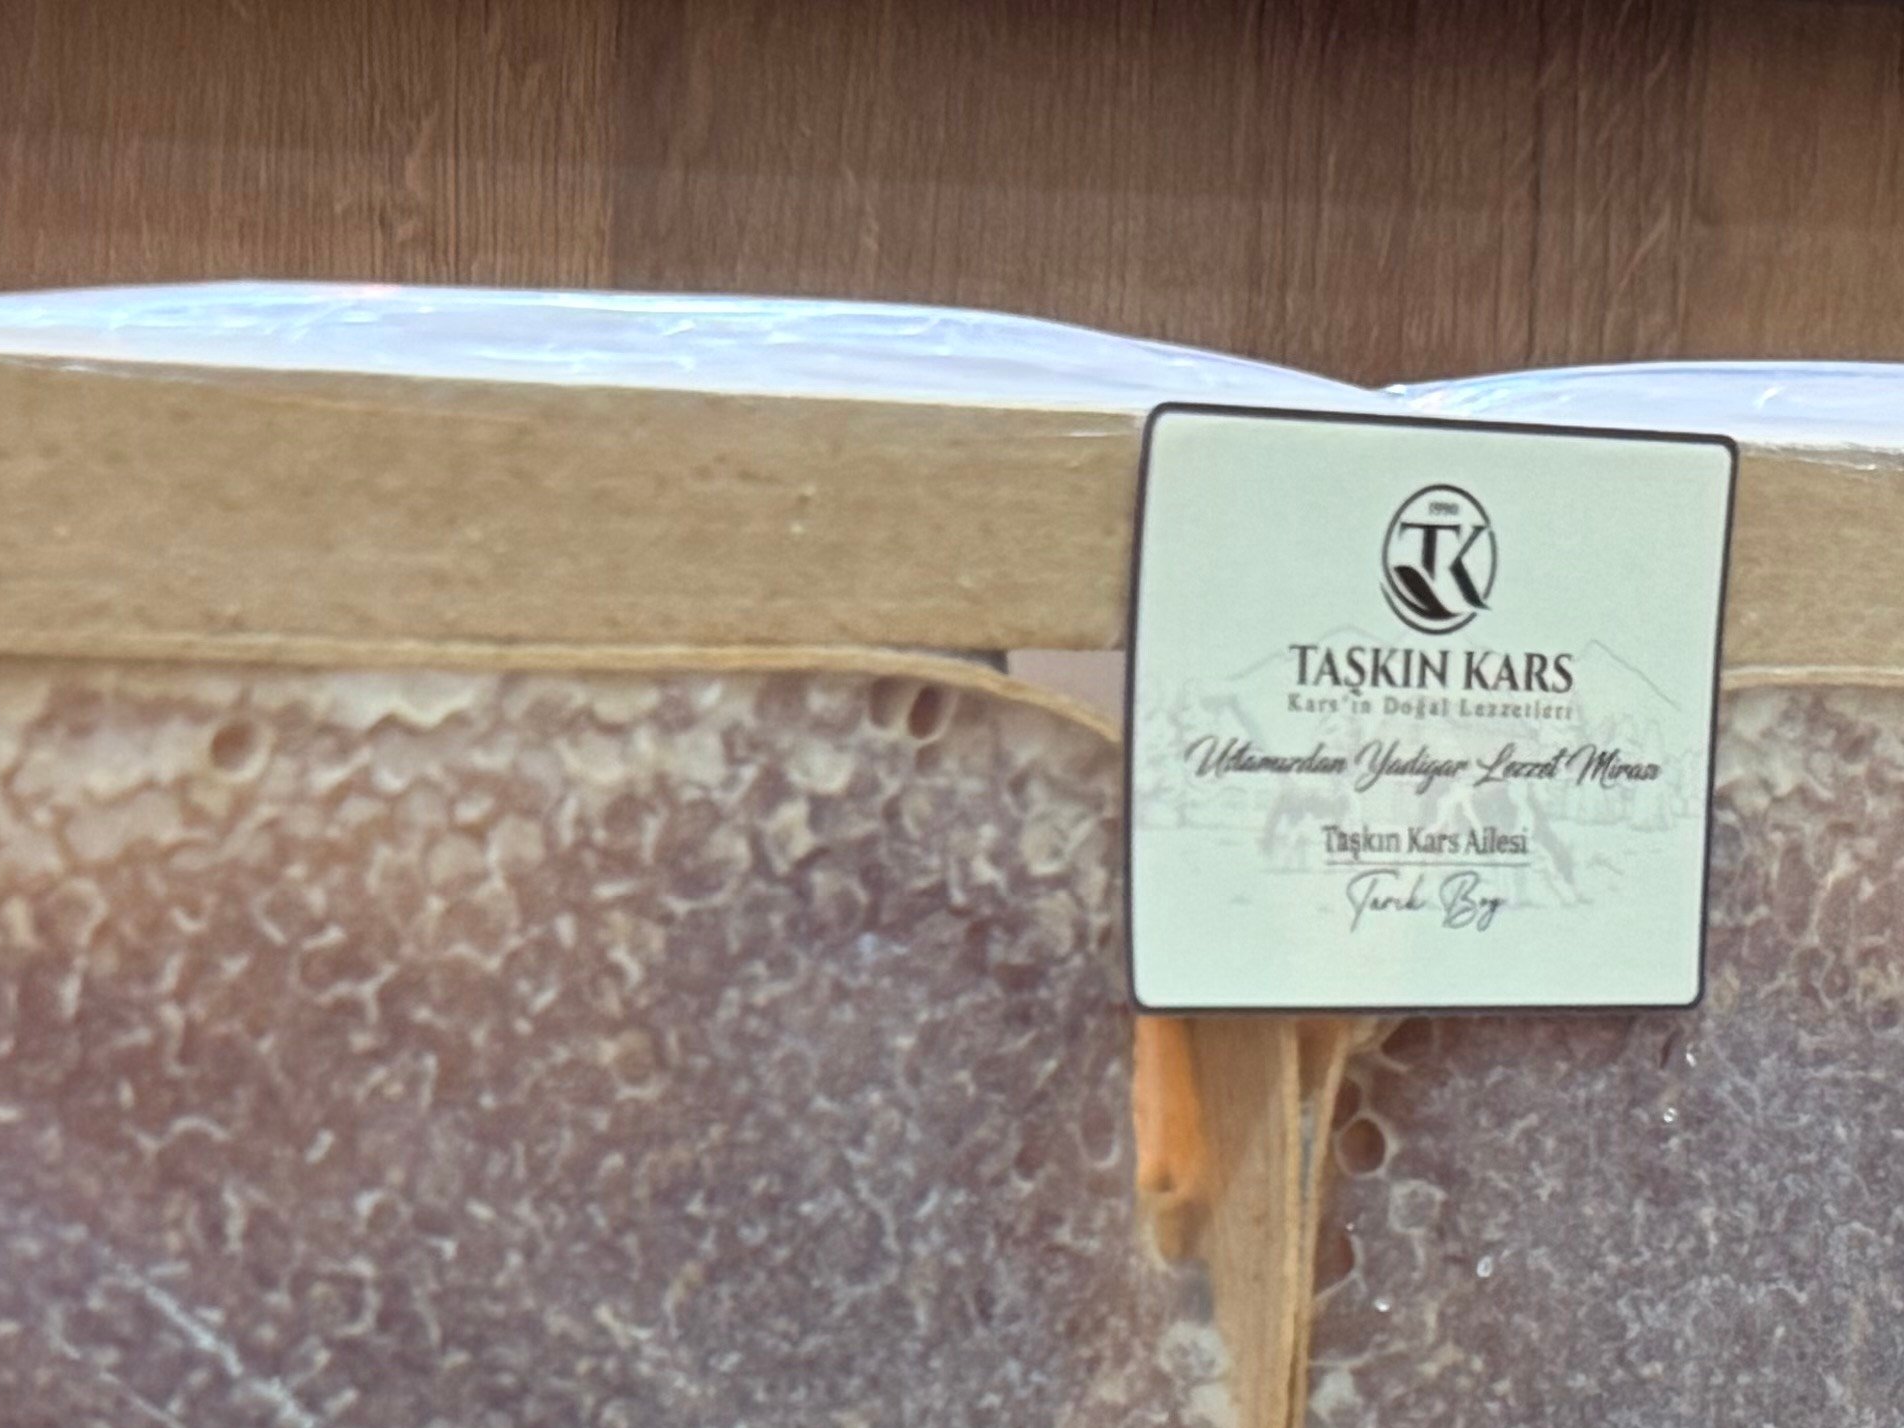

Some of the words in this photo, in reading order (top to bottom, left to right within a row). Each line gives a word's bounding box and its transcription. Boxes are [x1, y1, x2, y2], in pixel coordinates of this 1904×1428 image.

[1289, 644, 1449, 697] TAŞKIN
[1462, 650, 1574, 694] KARS
[1407, 826, 1459, 854] Kars
[1465, 825, 1530, 855] Ailesi
